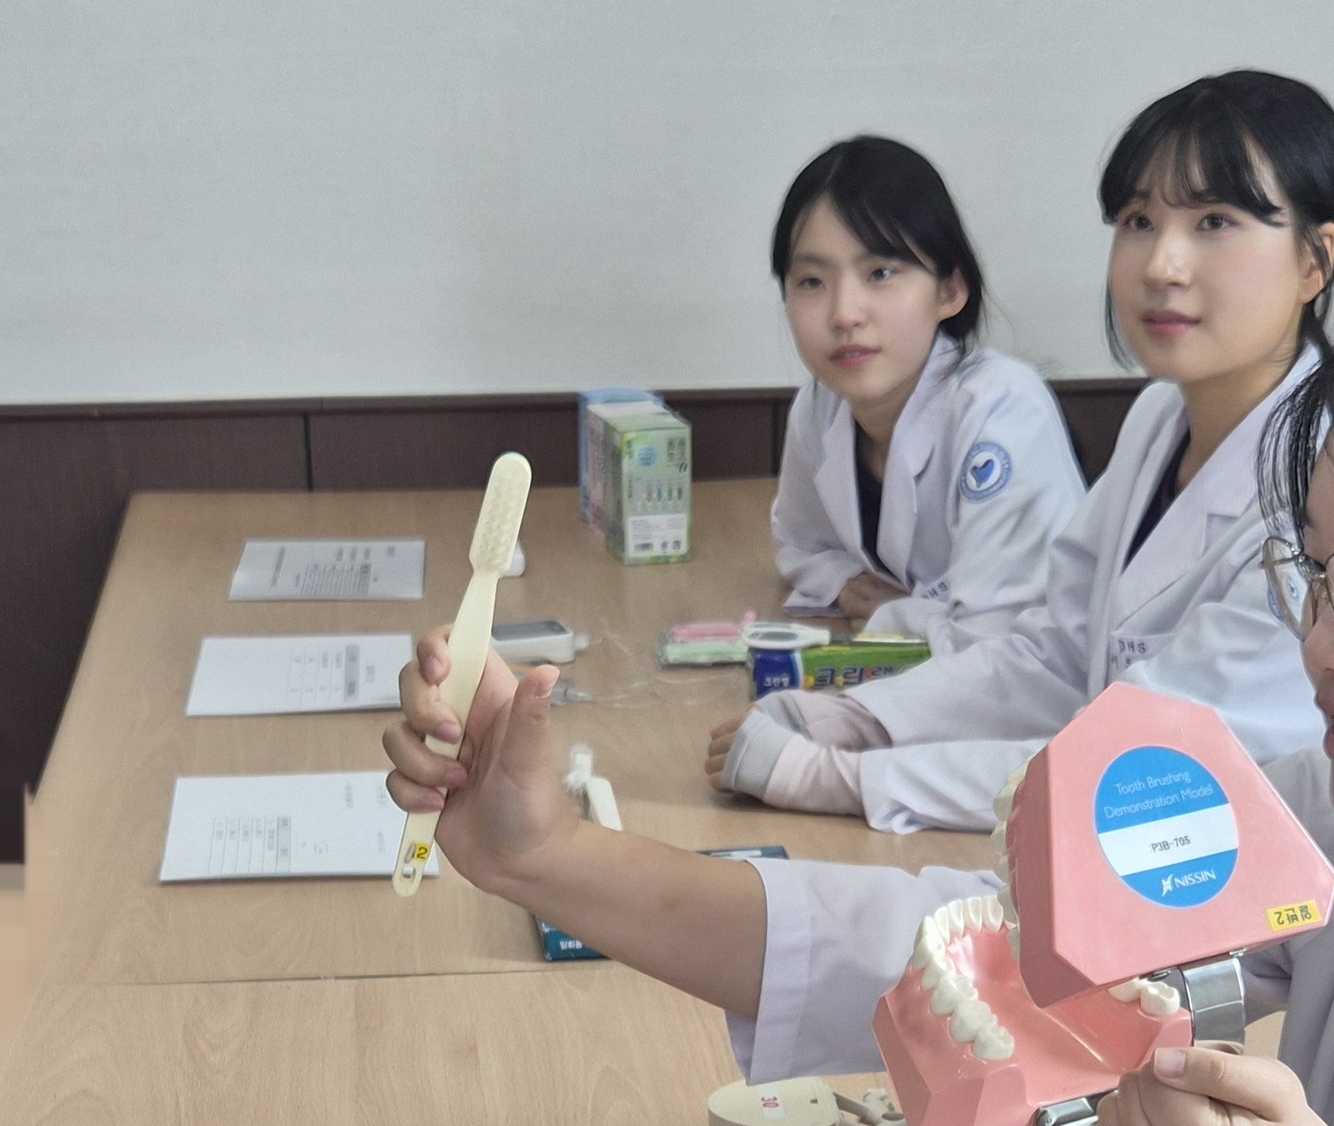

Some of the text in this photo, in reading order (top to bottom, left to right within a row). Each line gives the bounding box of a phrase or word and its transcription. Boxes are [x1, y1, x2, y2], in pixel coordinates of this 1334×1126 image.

[1114, 768, 1192, 797] Tooth Brushing
[1104, 783, 1214, 820] Demonstration Model
[414, 844, 428, 860] 2
[1174, 868, 1217, 890] NISSIN
